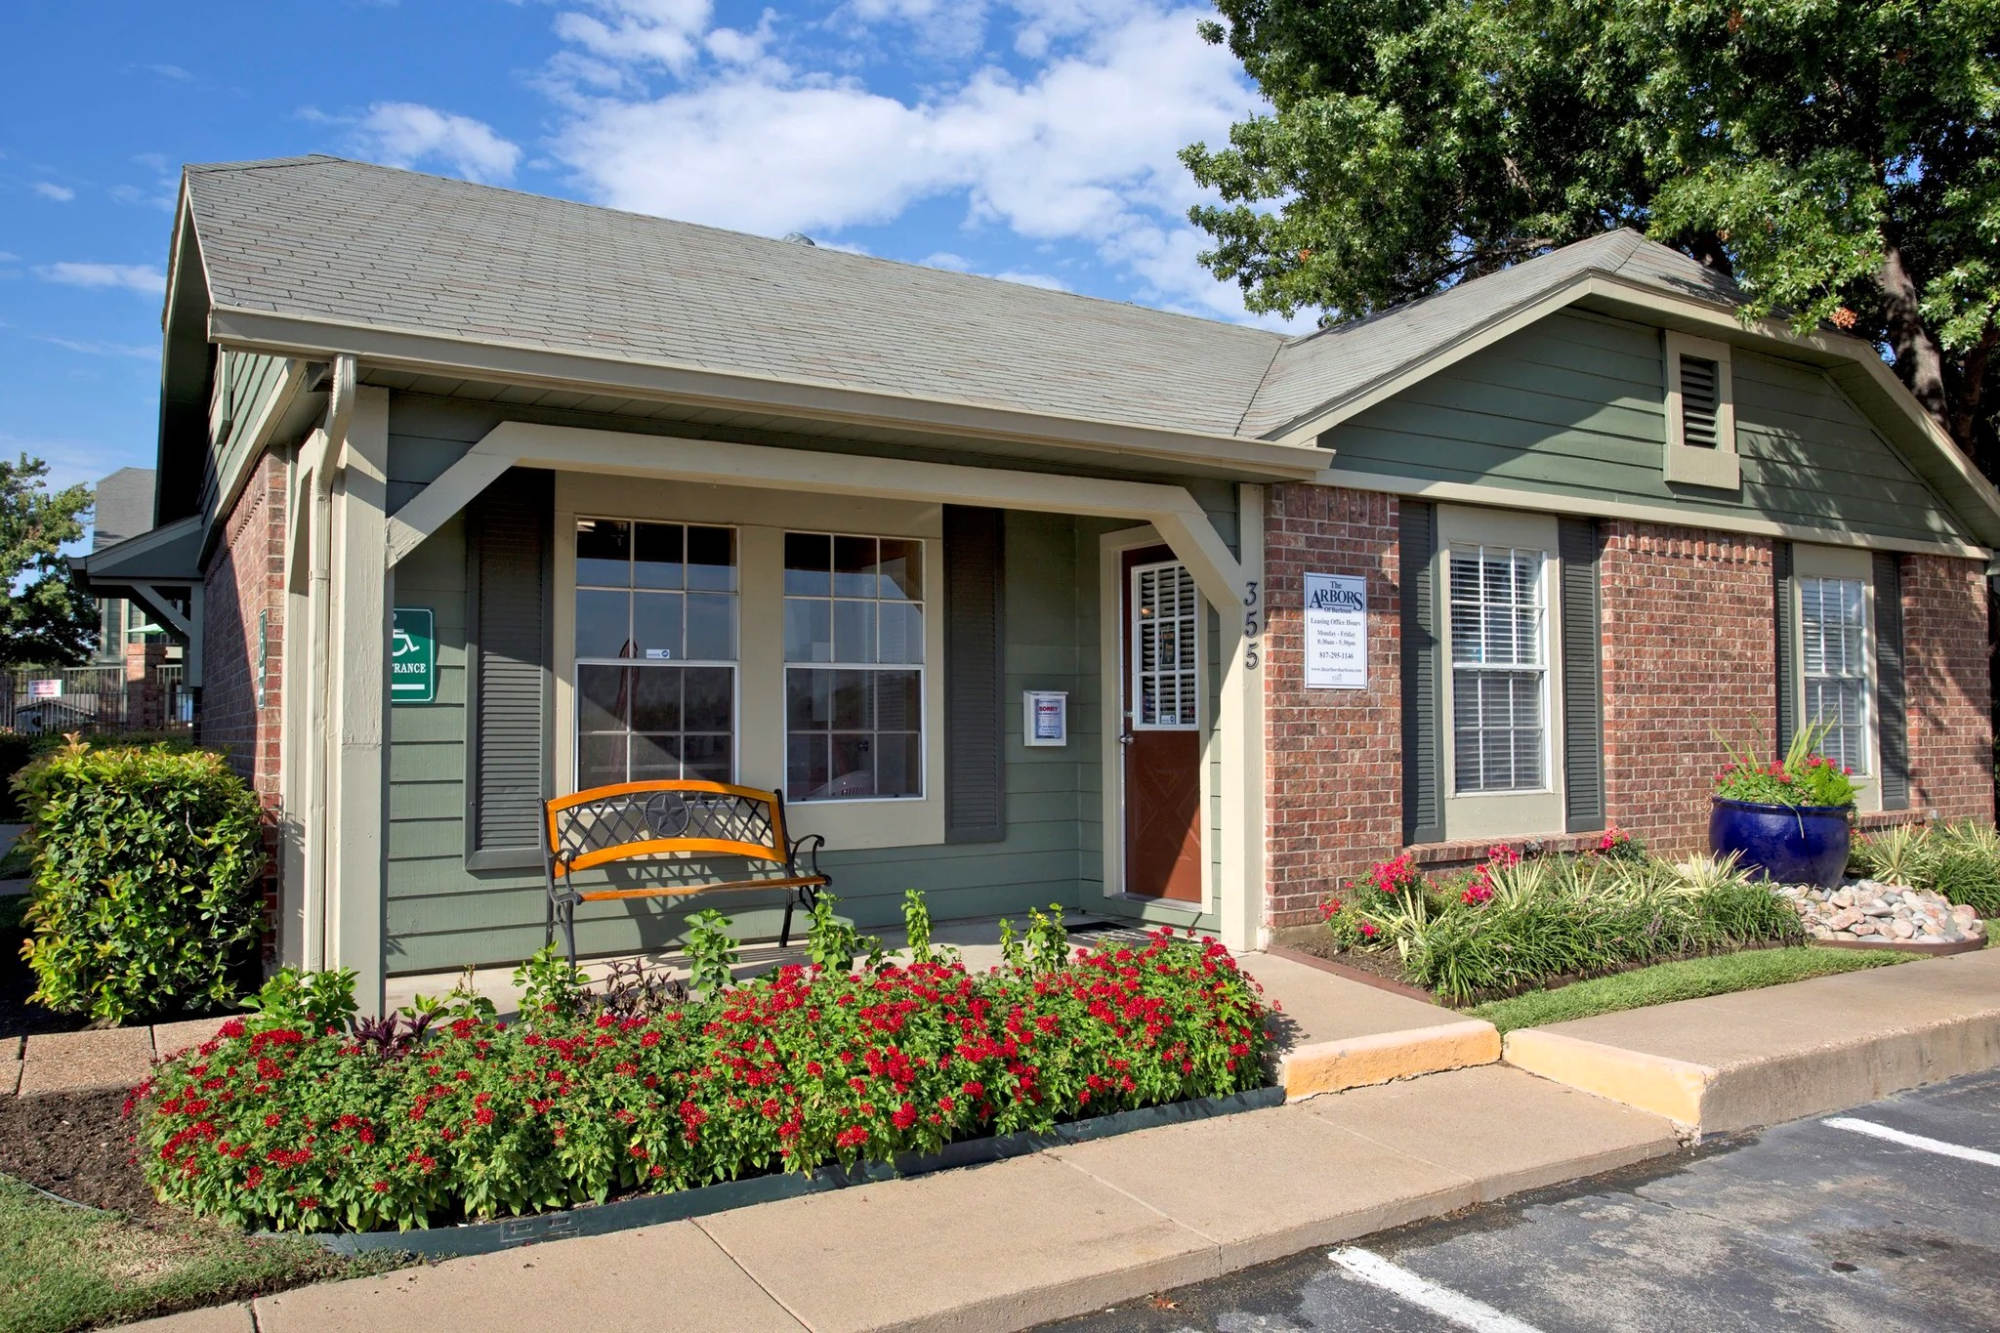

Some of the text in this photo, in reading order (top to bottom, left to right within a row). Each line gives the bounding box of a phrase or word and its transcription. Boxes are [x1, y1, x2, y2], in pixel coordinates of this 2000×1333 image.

[1330, 581, 1342, 589] The
[1309, 589, 1363, 611] ARBORS
[1310, 617, 1330, 626] Leasing
[392, 663, 426, 673] RANCE
